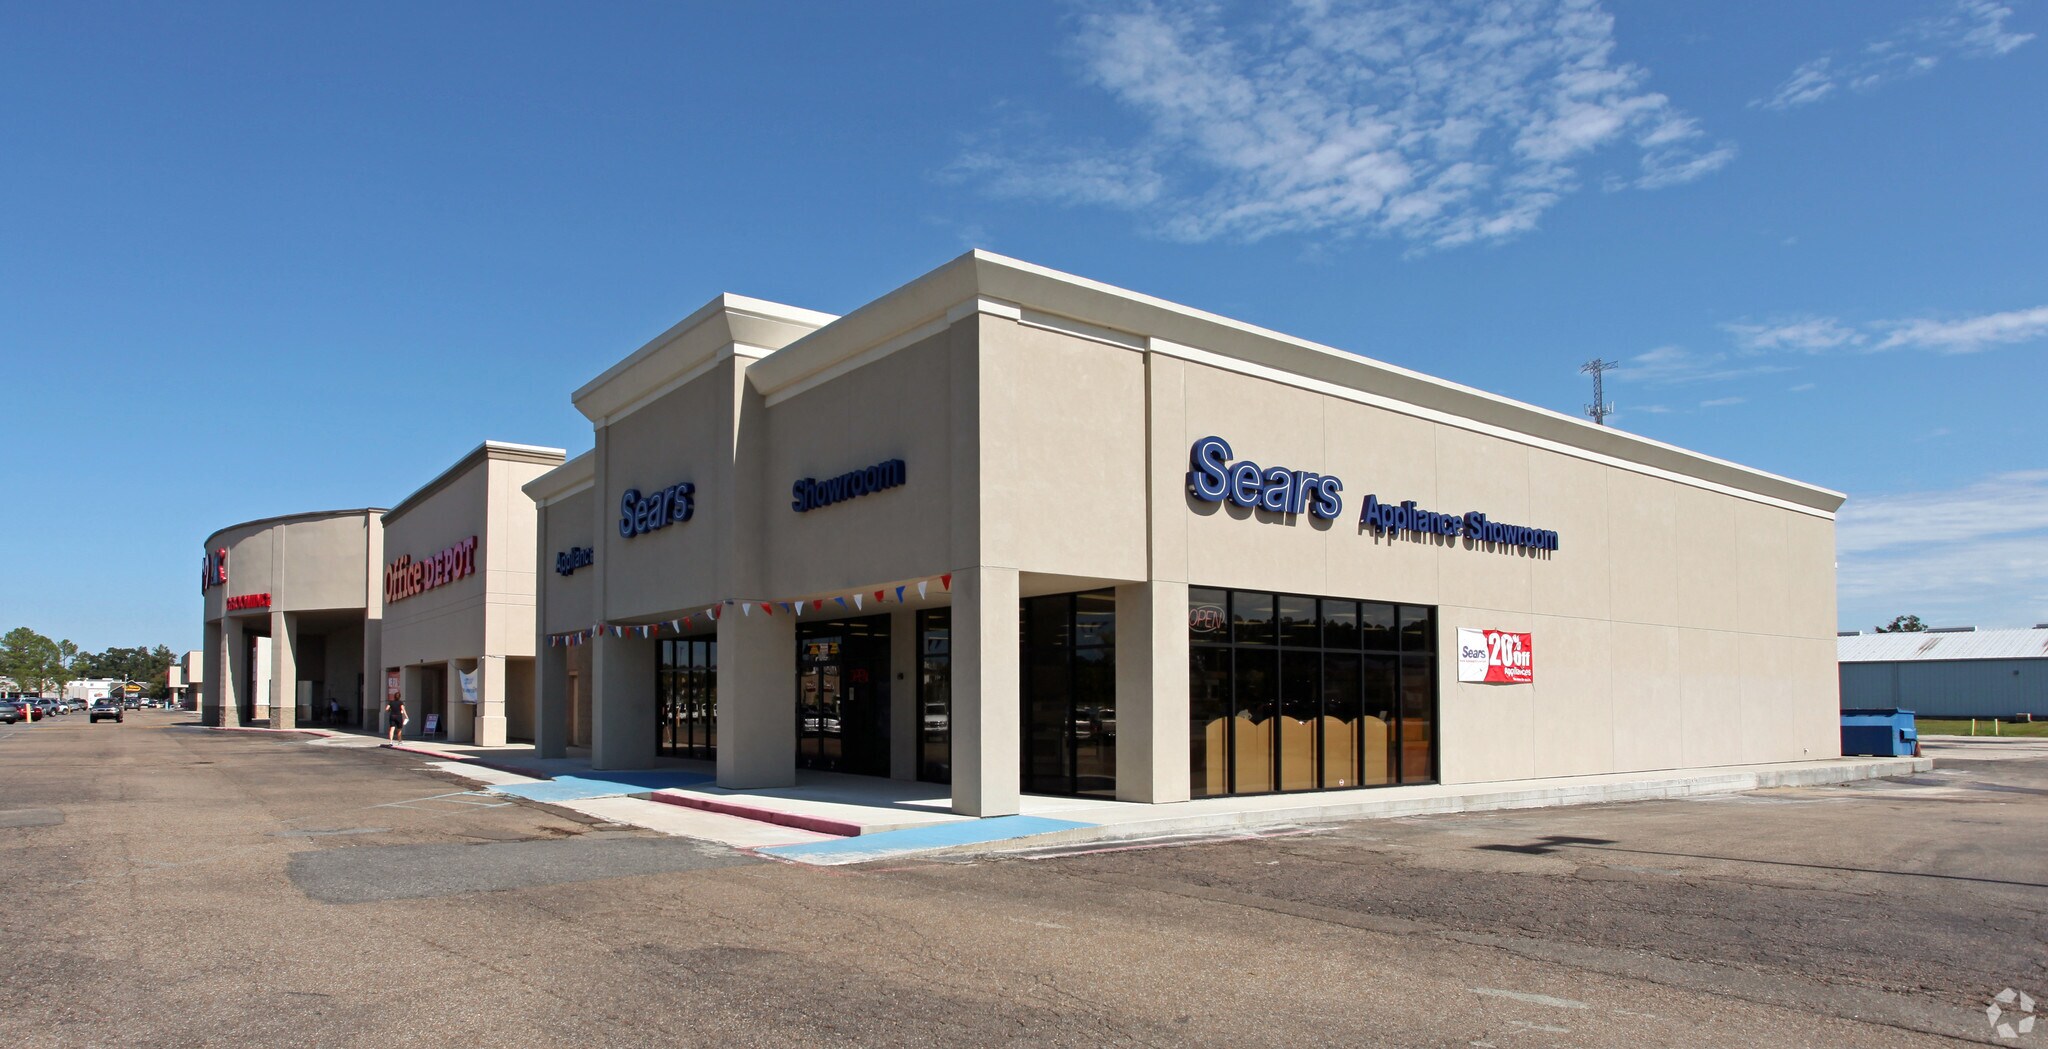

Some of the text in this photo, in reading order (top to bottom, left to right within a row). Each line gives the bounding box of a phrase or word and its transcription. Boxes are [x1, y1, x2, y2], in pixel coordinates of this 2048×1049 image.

[792, 459, 906, 512] Showroom
[1186, 436, 1343, 519] Sears
[619, 482, 695, 538] Sears
[1360, 494, 1558, 550] Appliance Showroom
[384, 536, 477, 604] Office DEPOT
[1189, 608, 1222, 629] OPEN
[1462, 645, 1486, 659] Sears
